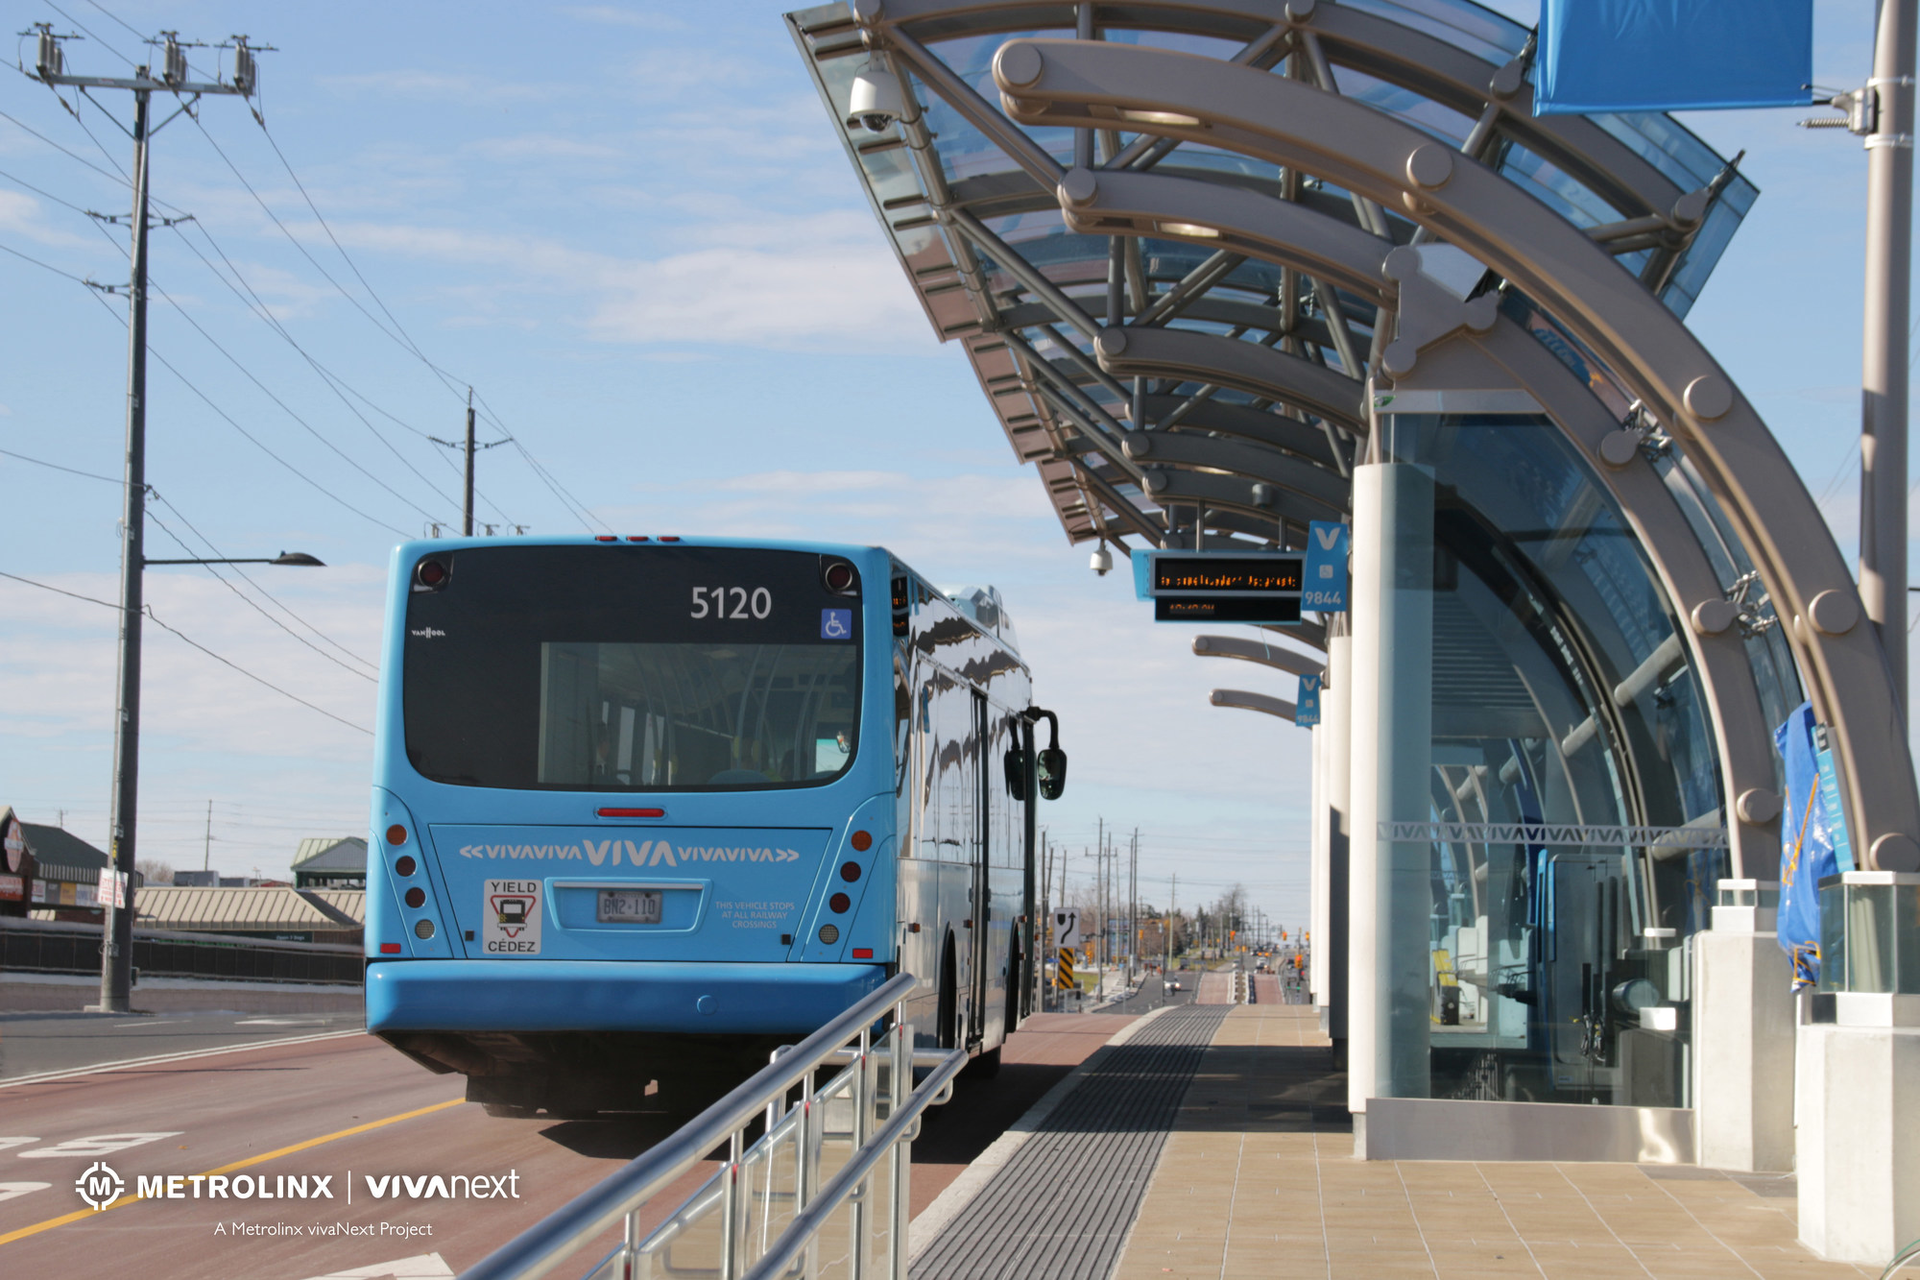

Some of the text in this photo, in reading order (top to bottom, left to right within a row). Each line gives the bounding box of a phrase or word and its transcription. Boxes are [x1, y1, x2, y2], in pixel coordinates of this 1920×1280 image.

[690, 586, 772, 620] 5120
[1304, 590, 1342, 606] 9844
[582, 839, 678, 867] VIVA
[490, 881, 537, 893] YIELD
[715, 901, 795, 910] THIS VEHICLE STOPS
[722, 911, 788, 920] AT ALL RAILWAY
[732, 920, 777, 929] CROSSINGS
[488, 938, 536, 952] CÉDEZ
